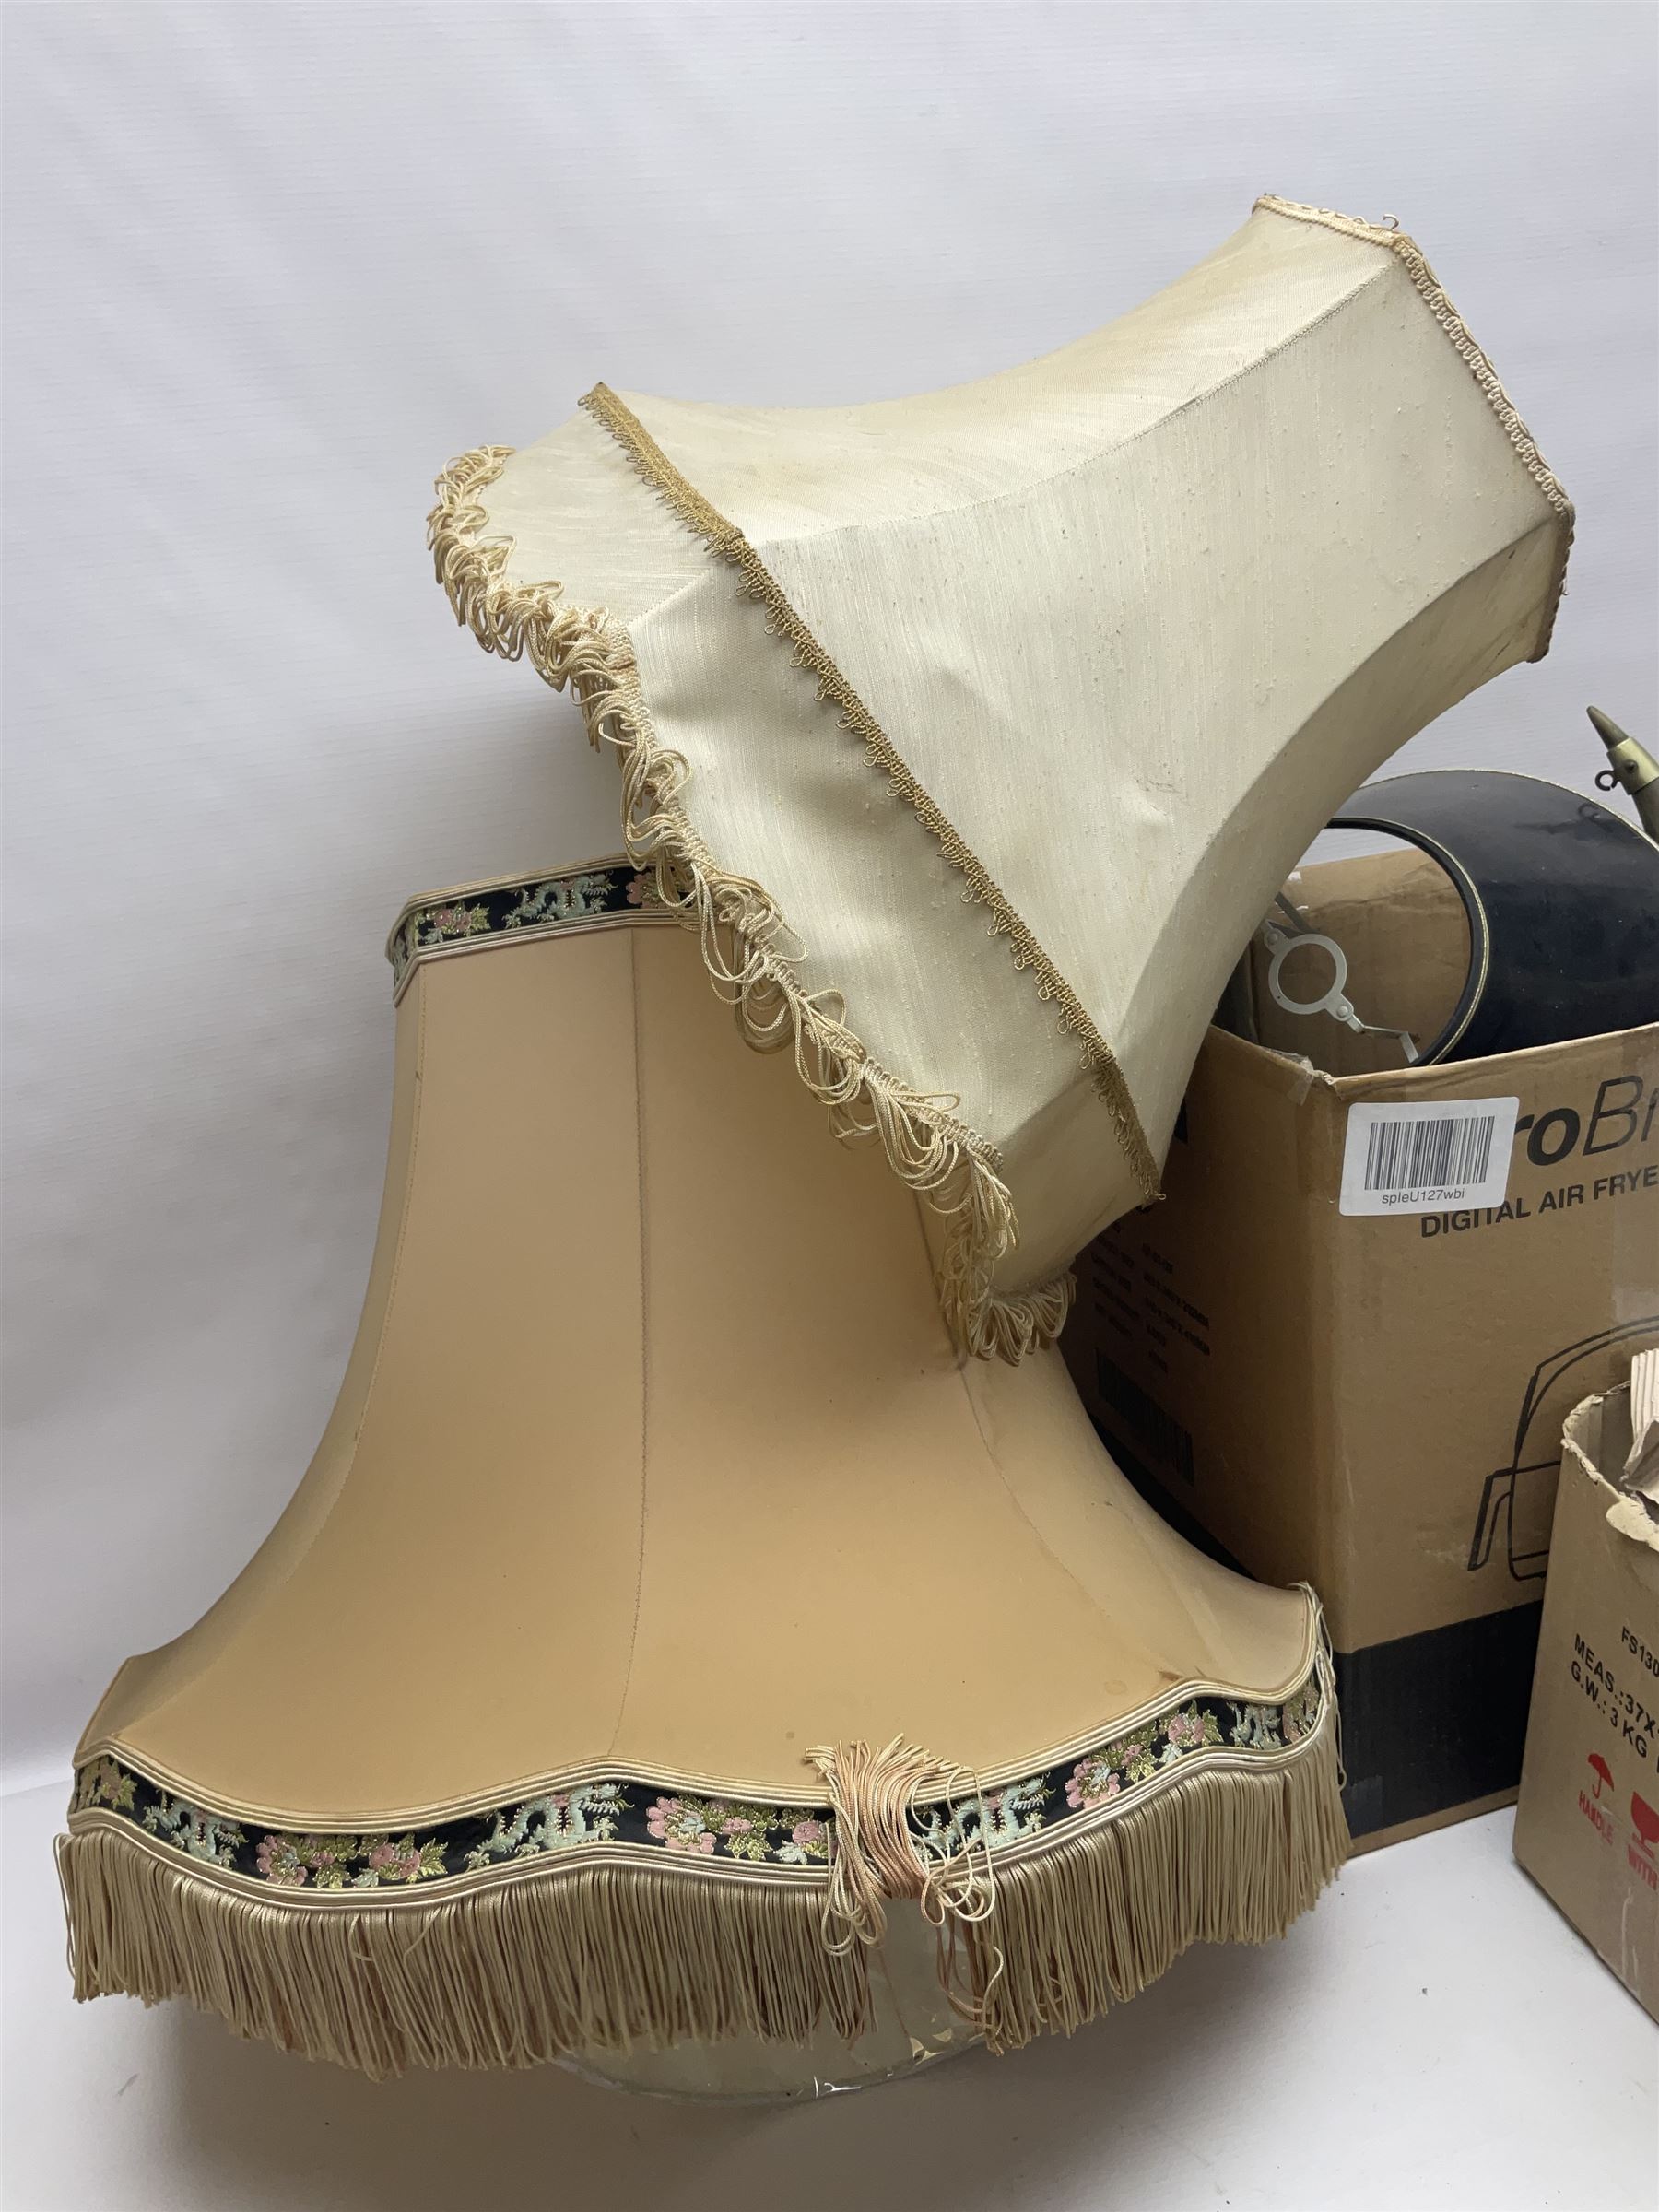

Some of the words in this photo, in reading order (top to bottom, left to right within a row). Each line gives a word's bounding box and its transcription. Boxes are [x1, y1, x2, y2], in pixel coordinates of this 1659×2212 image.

[1538, 1183, 1584, 1214] AIR
[1593, 1164, 1659, 1201] FRYE
[1571, 1660, 1606, 1714] G.W.:
[1610, 1707, 1619, 1728] 3
[1622, 1719, 1648, 1759] KG
[1578, 1789, 1614, 1846] HANDLE
[1628, 1843, 1658, 1891] WITH
